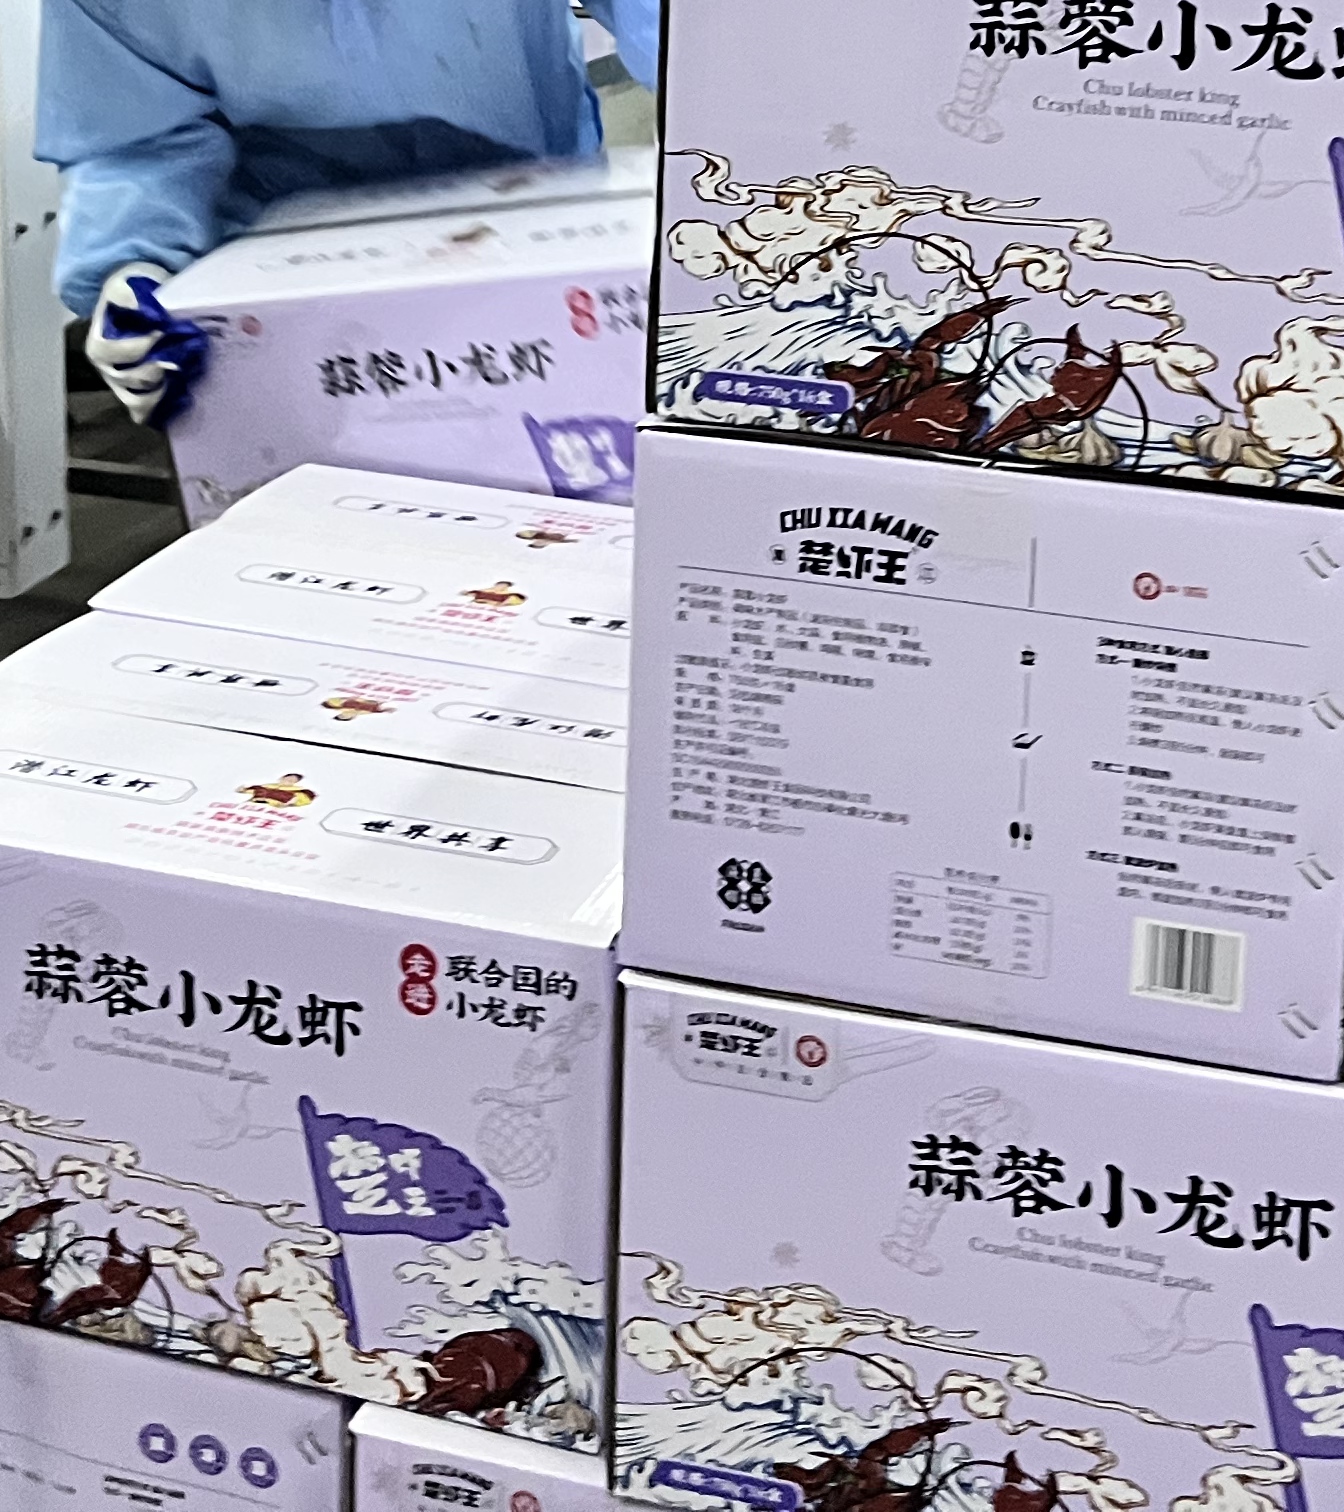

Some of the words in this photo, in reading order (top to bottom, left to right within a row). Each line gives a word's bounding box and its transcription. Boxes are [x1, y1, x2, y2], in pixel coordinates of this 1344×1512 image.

[780, 507, 822, 533] CHU
[826, 507, 866, 530] XIA
[869, 512, 939, 549] WANG
[798, 539, 910, 585] 楚虾王
[359, 818, 516, 854] 世界共享
[25, 943, 364, 1056] 蒜蓉小龙虾
[445, 955, 578, 1002] 联合国的
[446, 991, 546, 1032] 小龙虾
[908, 1134, 1335, 1262] 蒜蓉小龙虾
